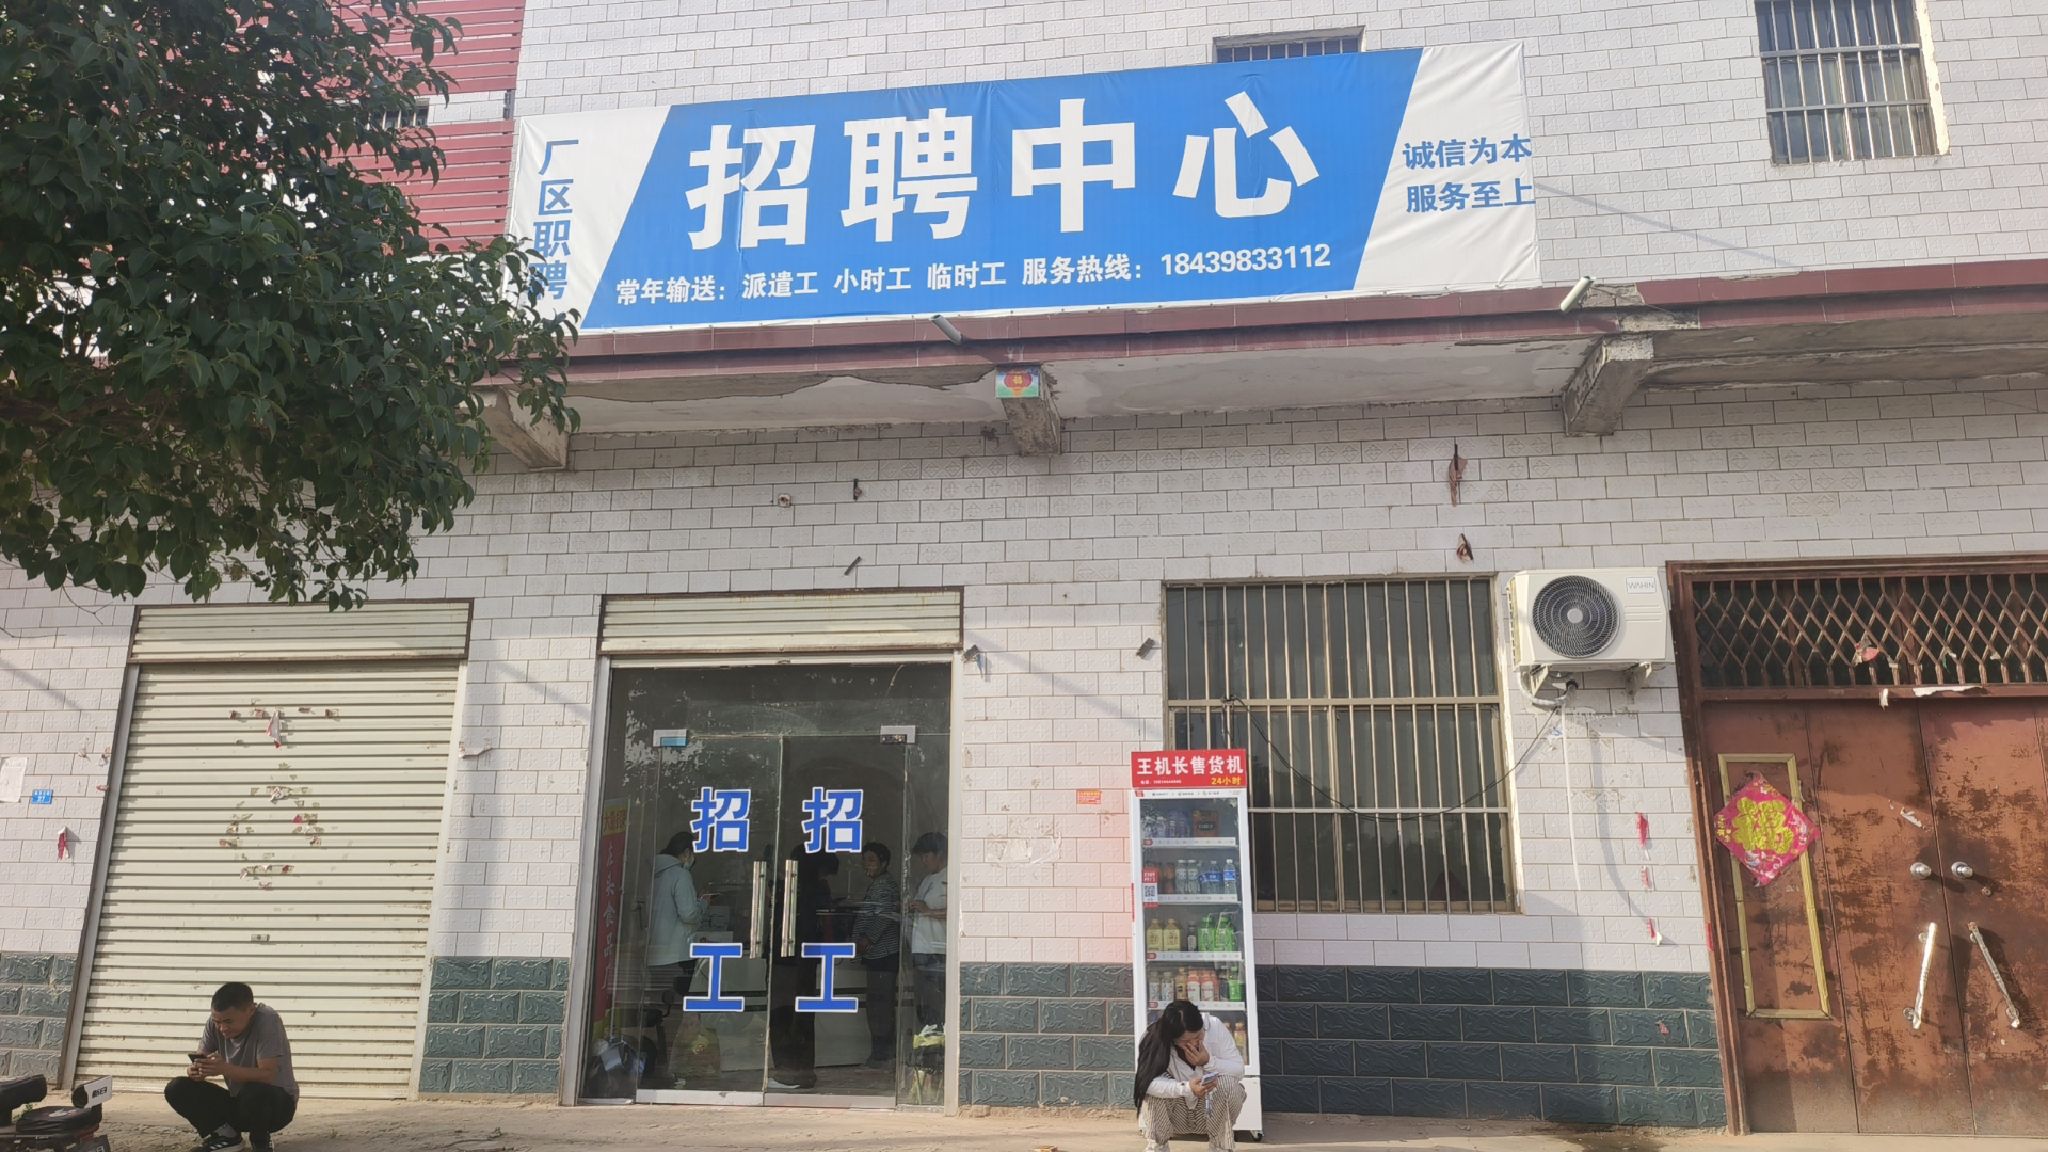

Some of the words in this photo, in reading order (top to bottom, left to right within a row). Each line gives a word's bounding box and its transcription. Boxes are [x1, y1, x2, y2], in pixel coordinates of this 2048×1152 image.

[1403, 134, 1533, 170] 诚信为本
[685, 91, 1320, 250] 招聘中心
[1406, 177, 1536, 213] 服务至上
[741, 270, 819, 300] 派遣工
[833, 265, 912, 295] 小时工
[927, 259, 1006, 290] 临时工
[1160, 243, 1332, 275] 18439833112
[1136, 755, 1244, 776] 王机长售货机
[1211, 776, 1242, 786] 24小时
